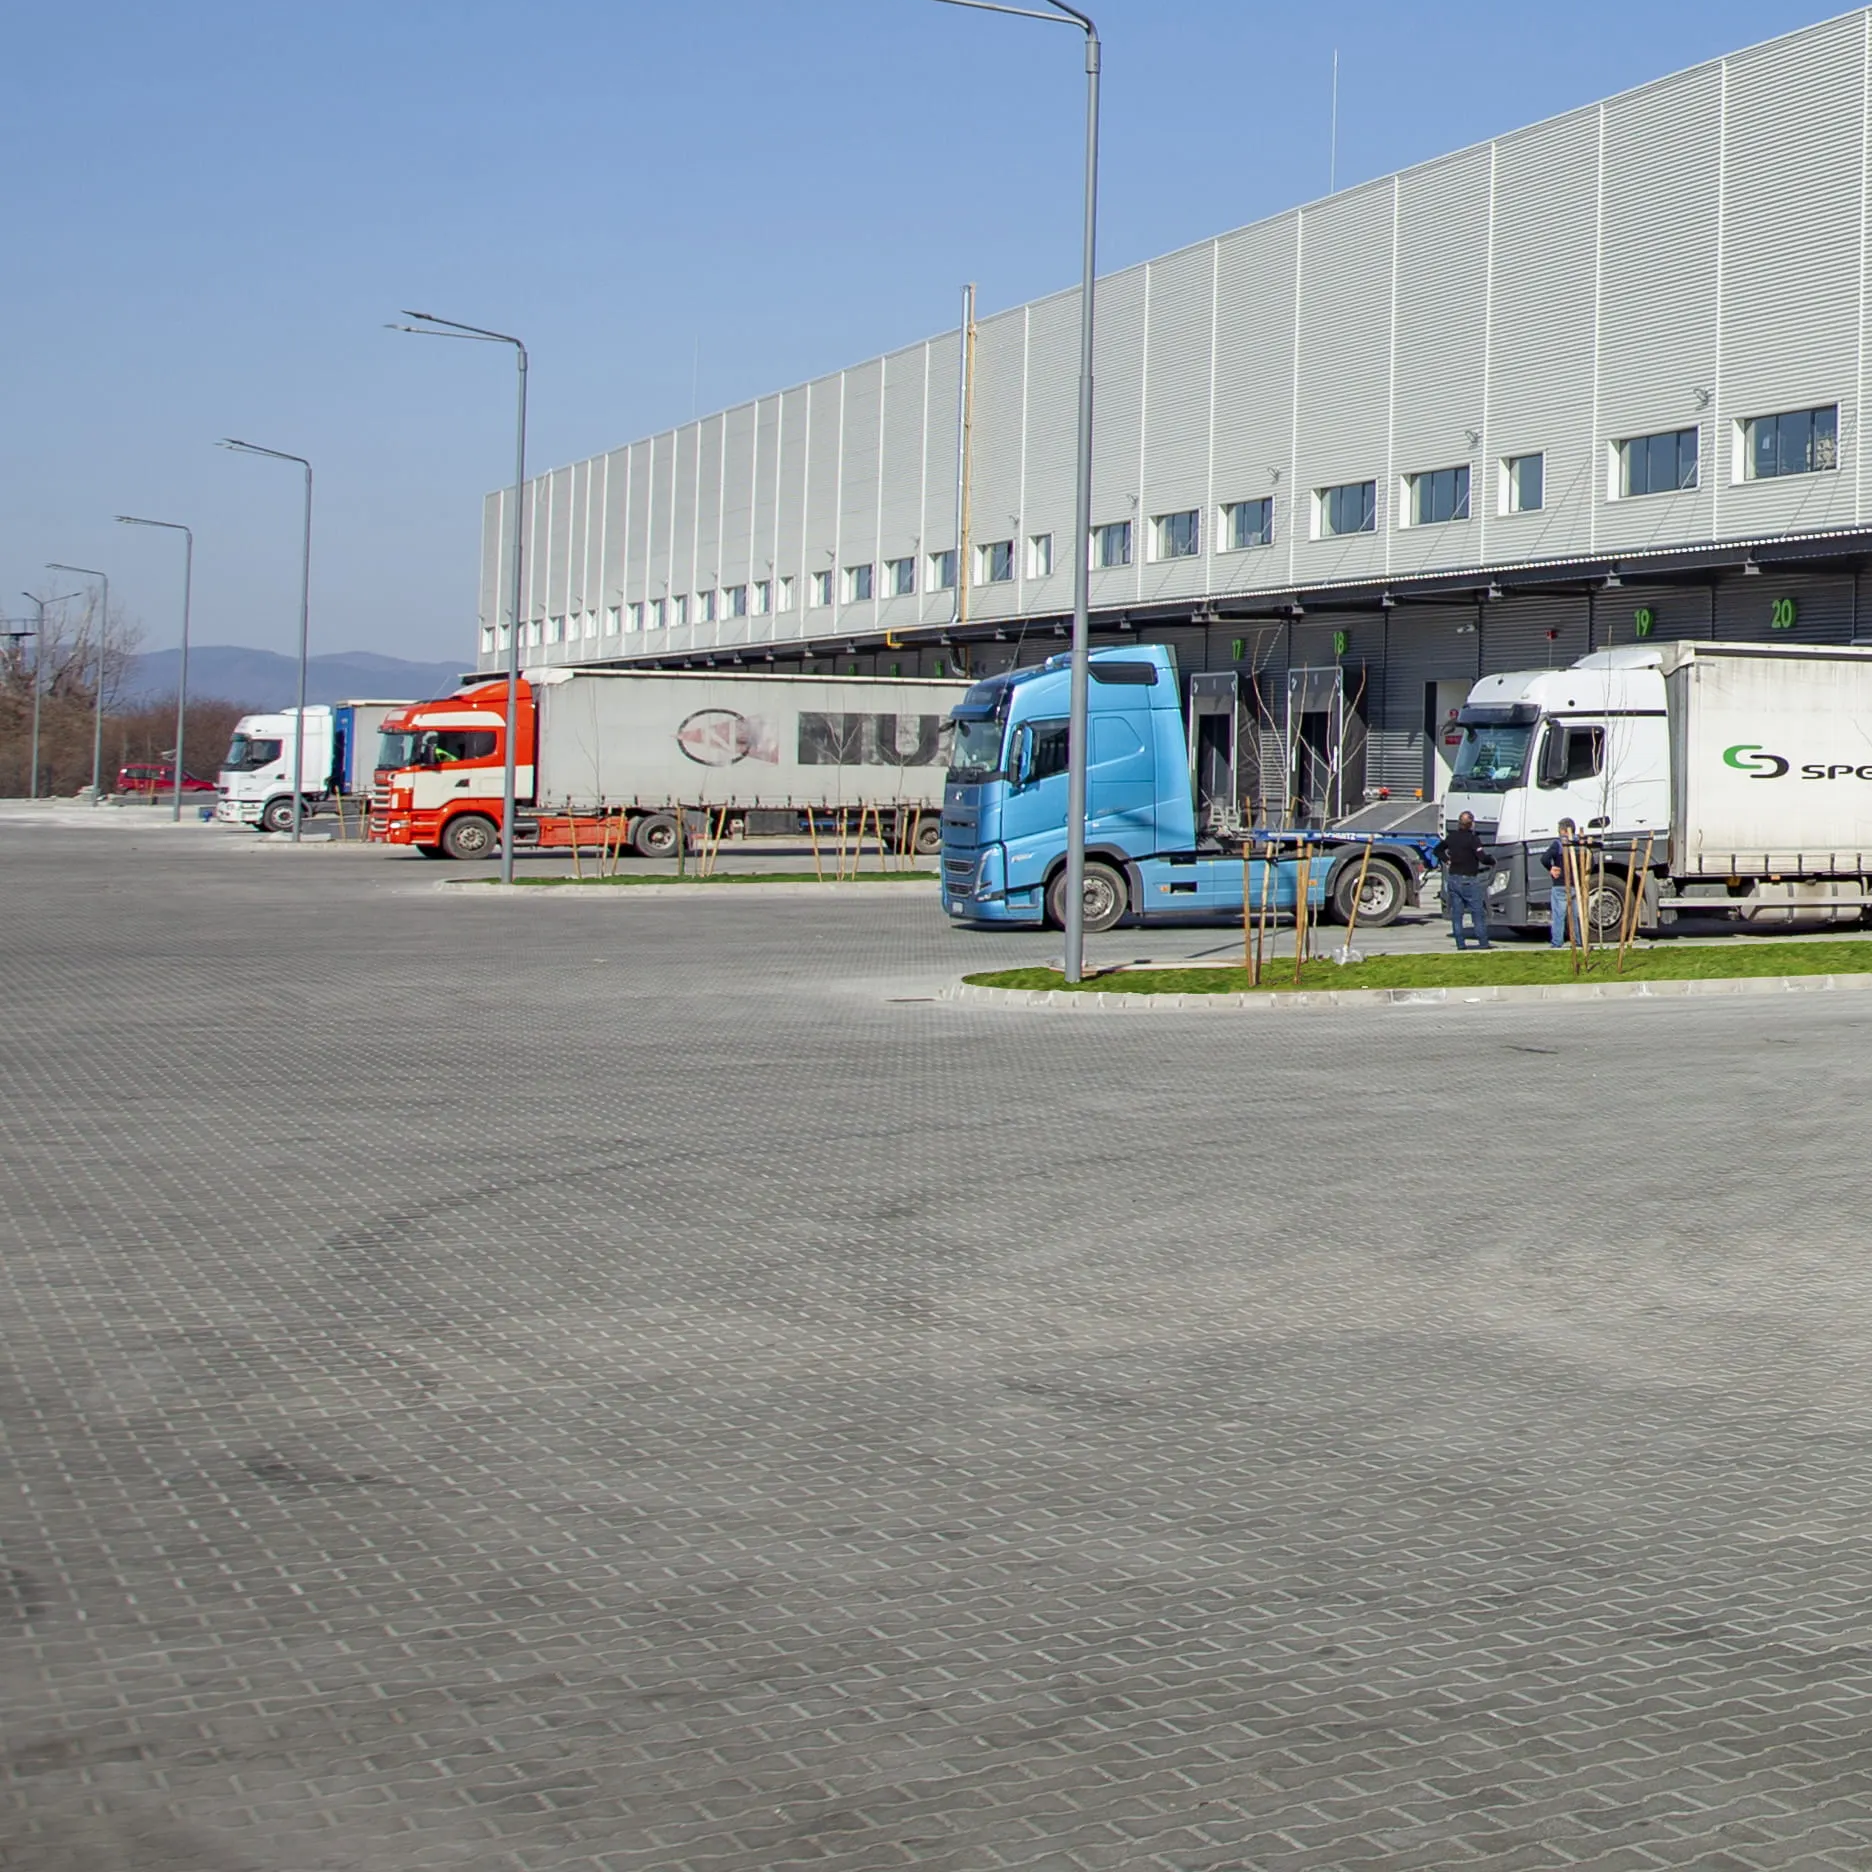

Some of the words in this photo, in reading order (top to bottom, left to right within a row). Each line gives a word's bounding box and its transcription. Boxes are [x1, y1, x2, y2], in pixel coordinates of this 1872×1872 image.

[1634, 608, 1653, 637] 19
[1771, 598, 1796, 629] 20
[1232, 639, 1244, 661] 17
[1333, 631, 1348, 655] 18
